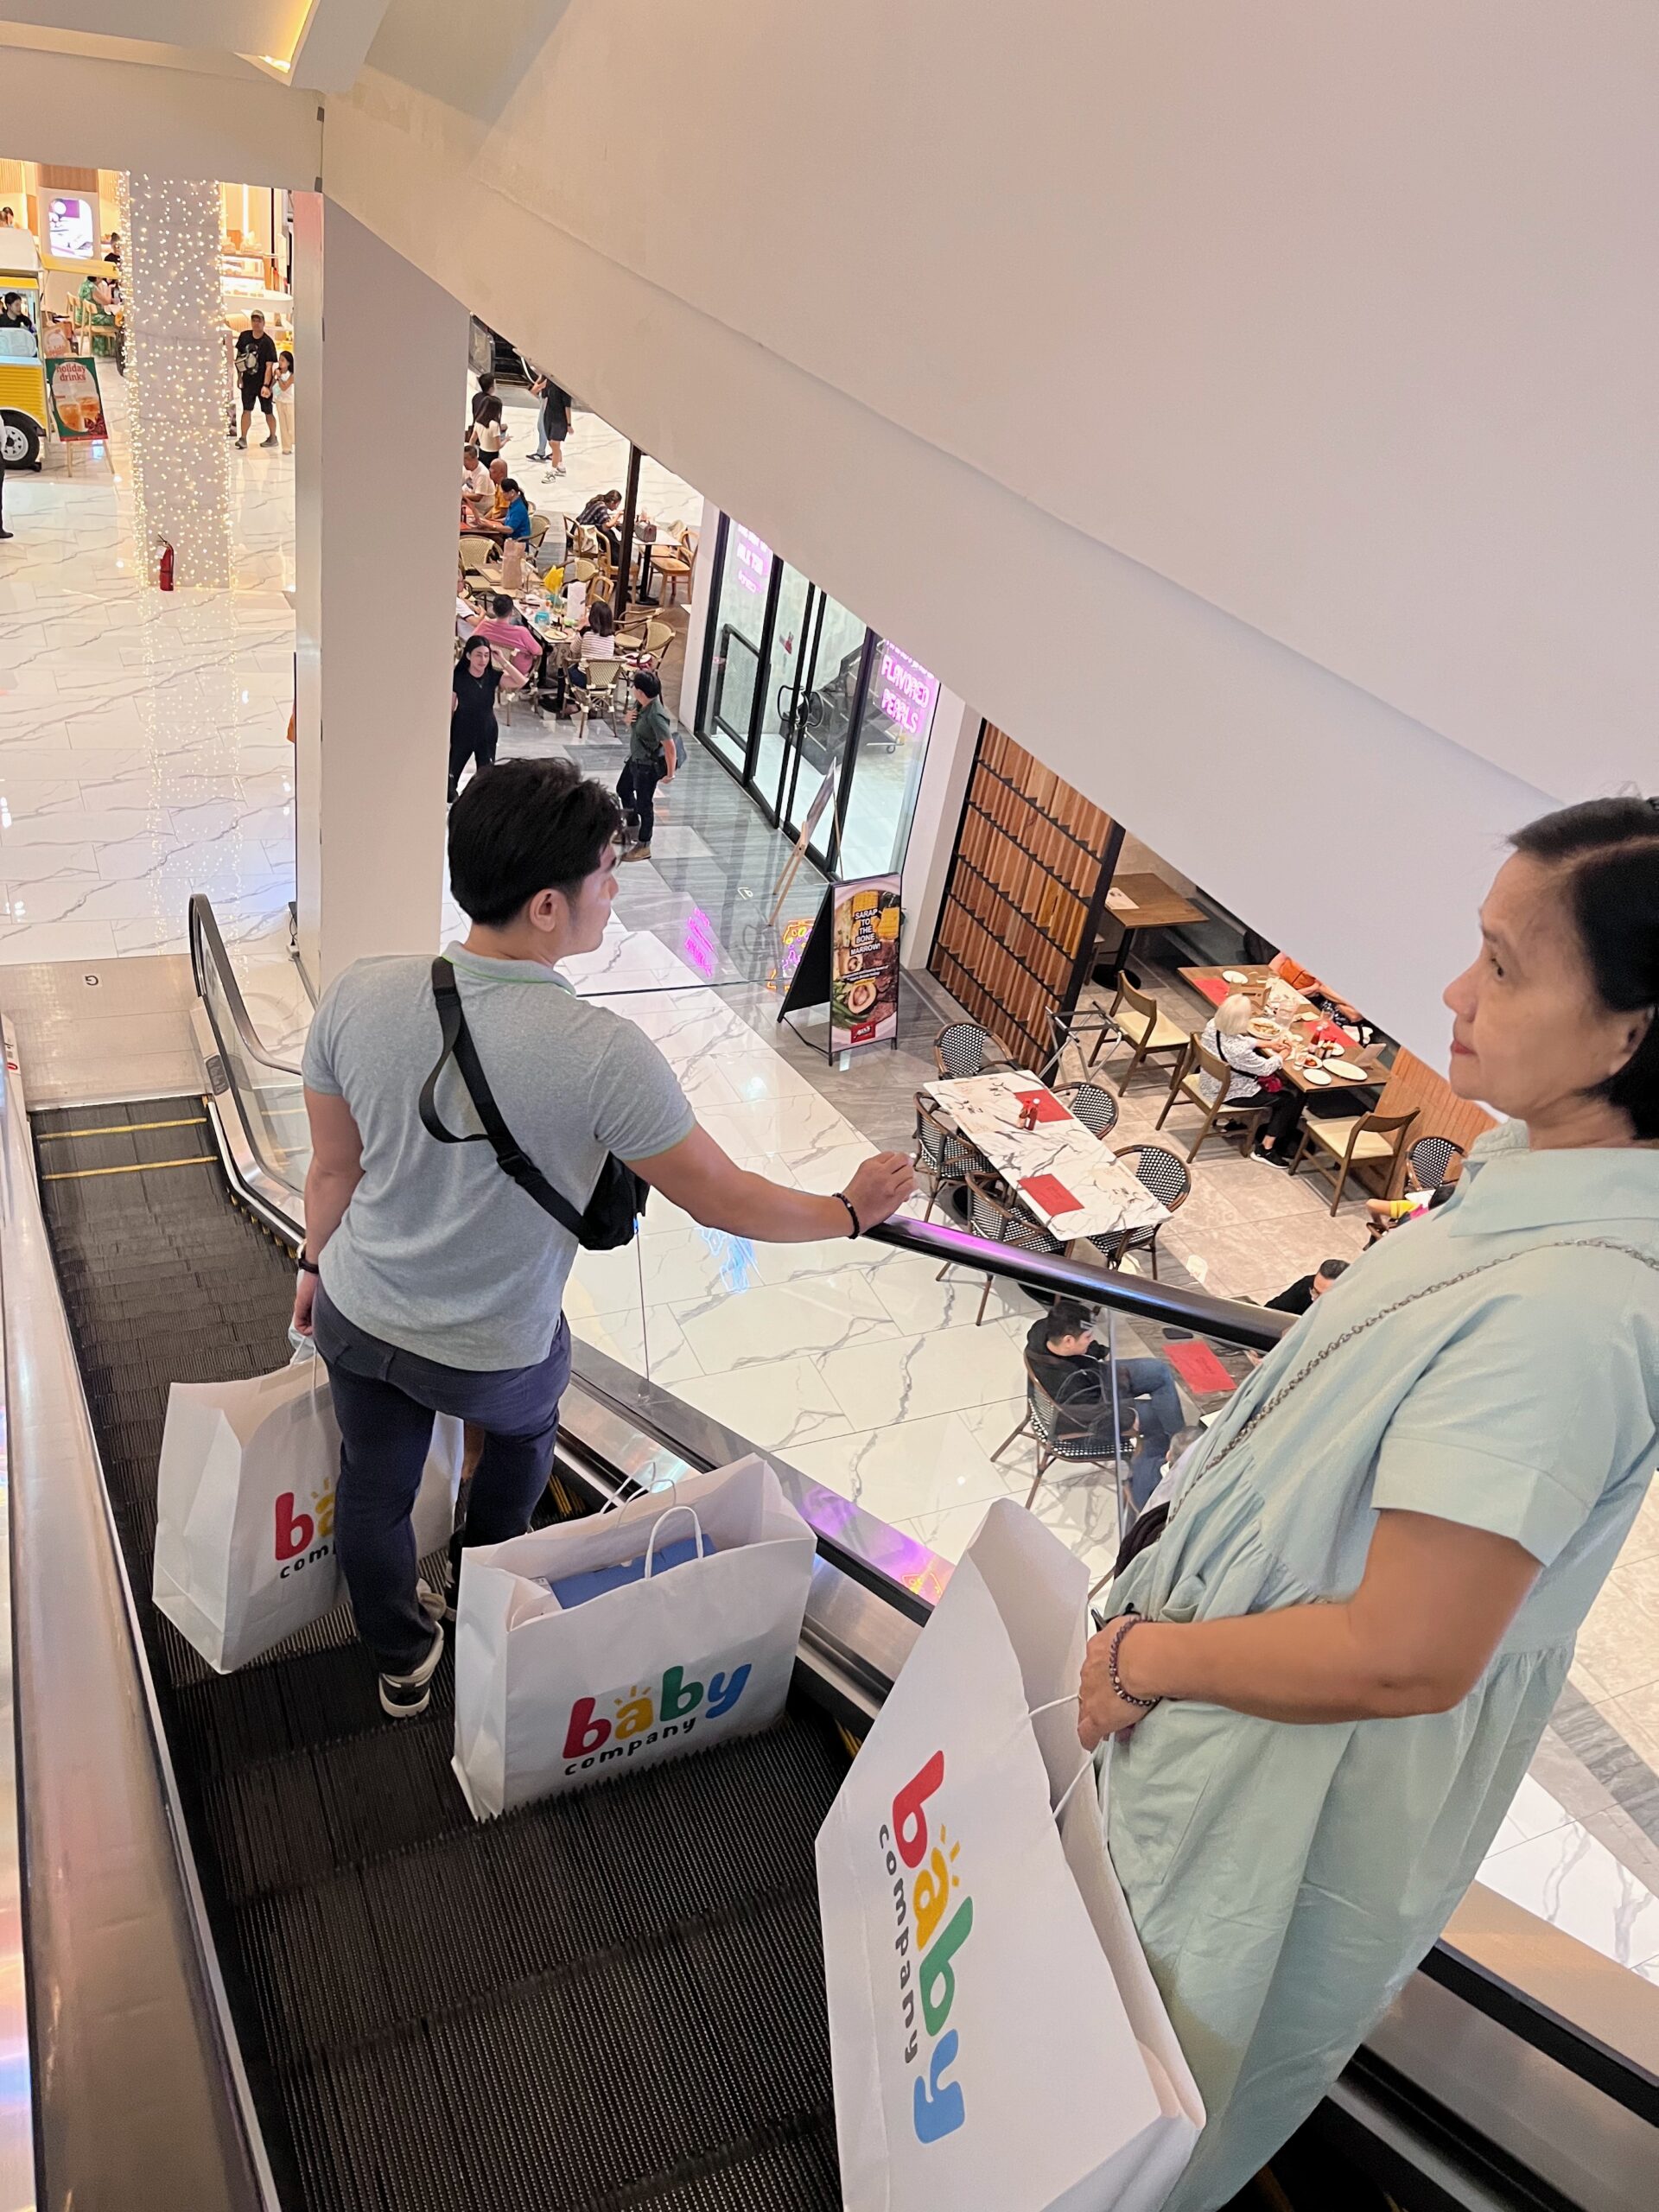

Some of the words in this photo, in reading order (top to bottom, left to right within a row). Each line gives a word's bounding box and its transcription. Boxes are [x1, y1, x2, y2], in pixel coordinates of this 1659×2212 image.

[55, 363, 86, 373] holiday
[60, 372, 86, 381] drinks
[882, 654, 930, 709] FLAVORED
[882, 689, 918, 734] PEARLS
[855, 909, 878, 920] SARAP
[859, 925, 873, 935] THE
[850, 943, 881, 956] MARROW!
[855, 933, 875, 944] BONE
[85, 976, 99, 986] G
[275, 1488, 335, 1561] ba
[280, 1541, 337, 1580] com
[563, 1663, 752, 1759] baby
[564, 1717, 696, 1777] company
[880, 1824, 918, 2064] company
[893, 1750, 974, 2144] baby
